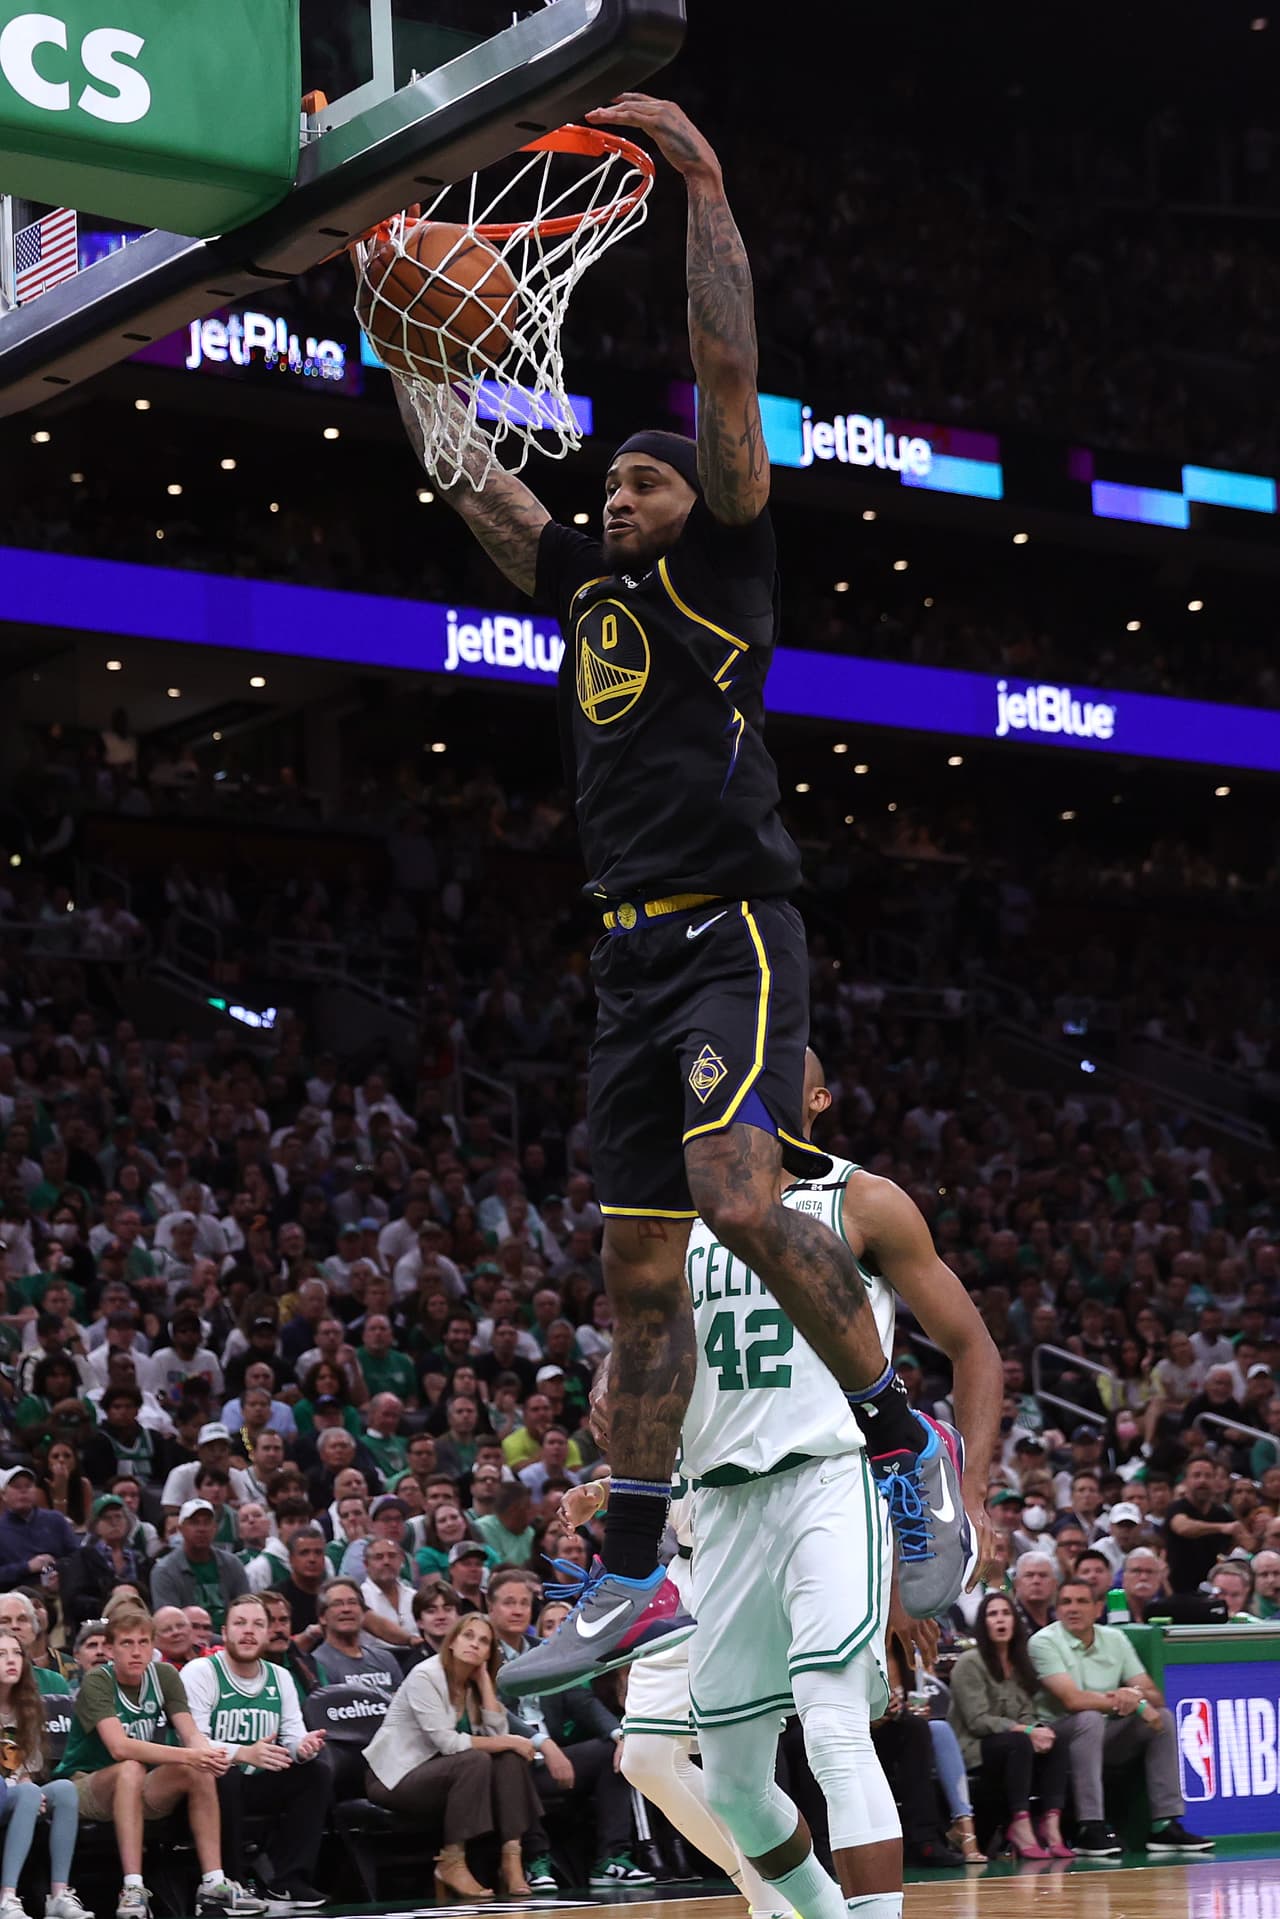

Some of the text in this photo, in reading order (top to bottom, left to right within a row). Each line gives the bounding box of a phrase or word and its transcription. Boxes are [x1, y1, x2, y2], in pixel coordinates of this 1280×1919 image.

[800, 405, 931, 476] jetBlue
[444, 610, 566, 673] jetBlu
[602, 614, 617, 650] 0
[995, 680, 1114, 739] jetBlue
[795, 1200, 823, 1212] VISTA
[704, 1308, 794, 1391] 42
[215, 1708, 280, 1743] BOSTON
[326, 1699, 387, 1721] @celtics
[1217, 1698, 1280, 1798] NB
